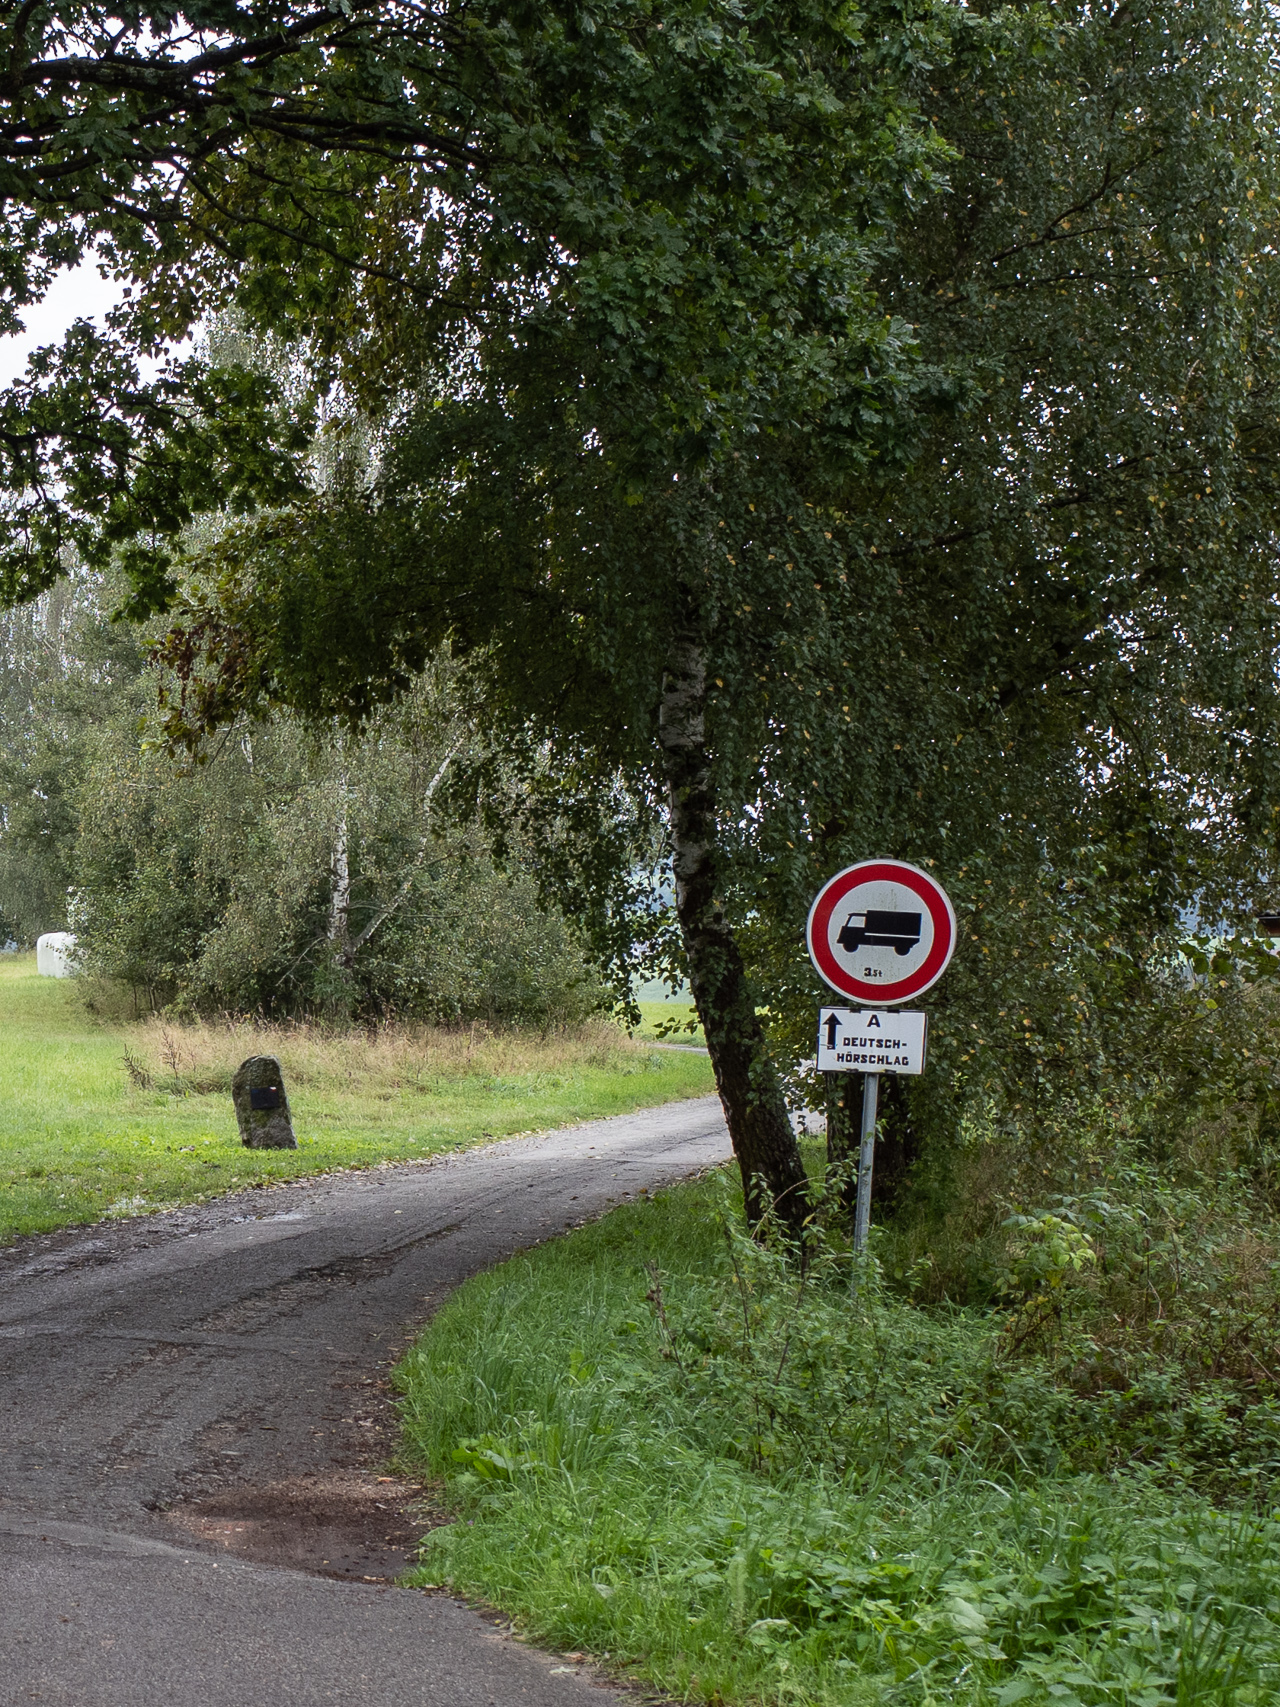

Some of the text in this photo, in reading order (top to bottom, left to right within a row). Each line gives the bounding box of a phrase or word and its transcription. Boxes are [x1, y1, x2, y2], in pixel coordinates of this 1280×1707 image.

[867, 1014, 881, 1028] A
[843, 1037, 907, 1049] DEUTSCH-
[836, 1051, 909, 1066] HÖRSCHLAG
